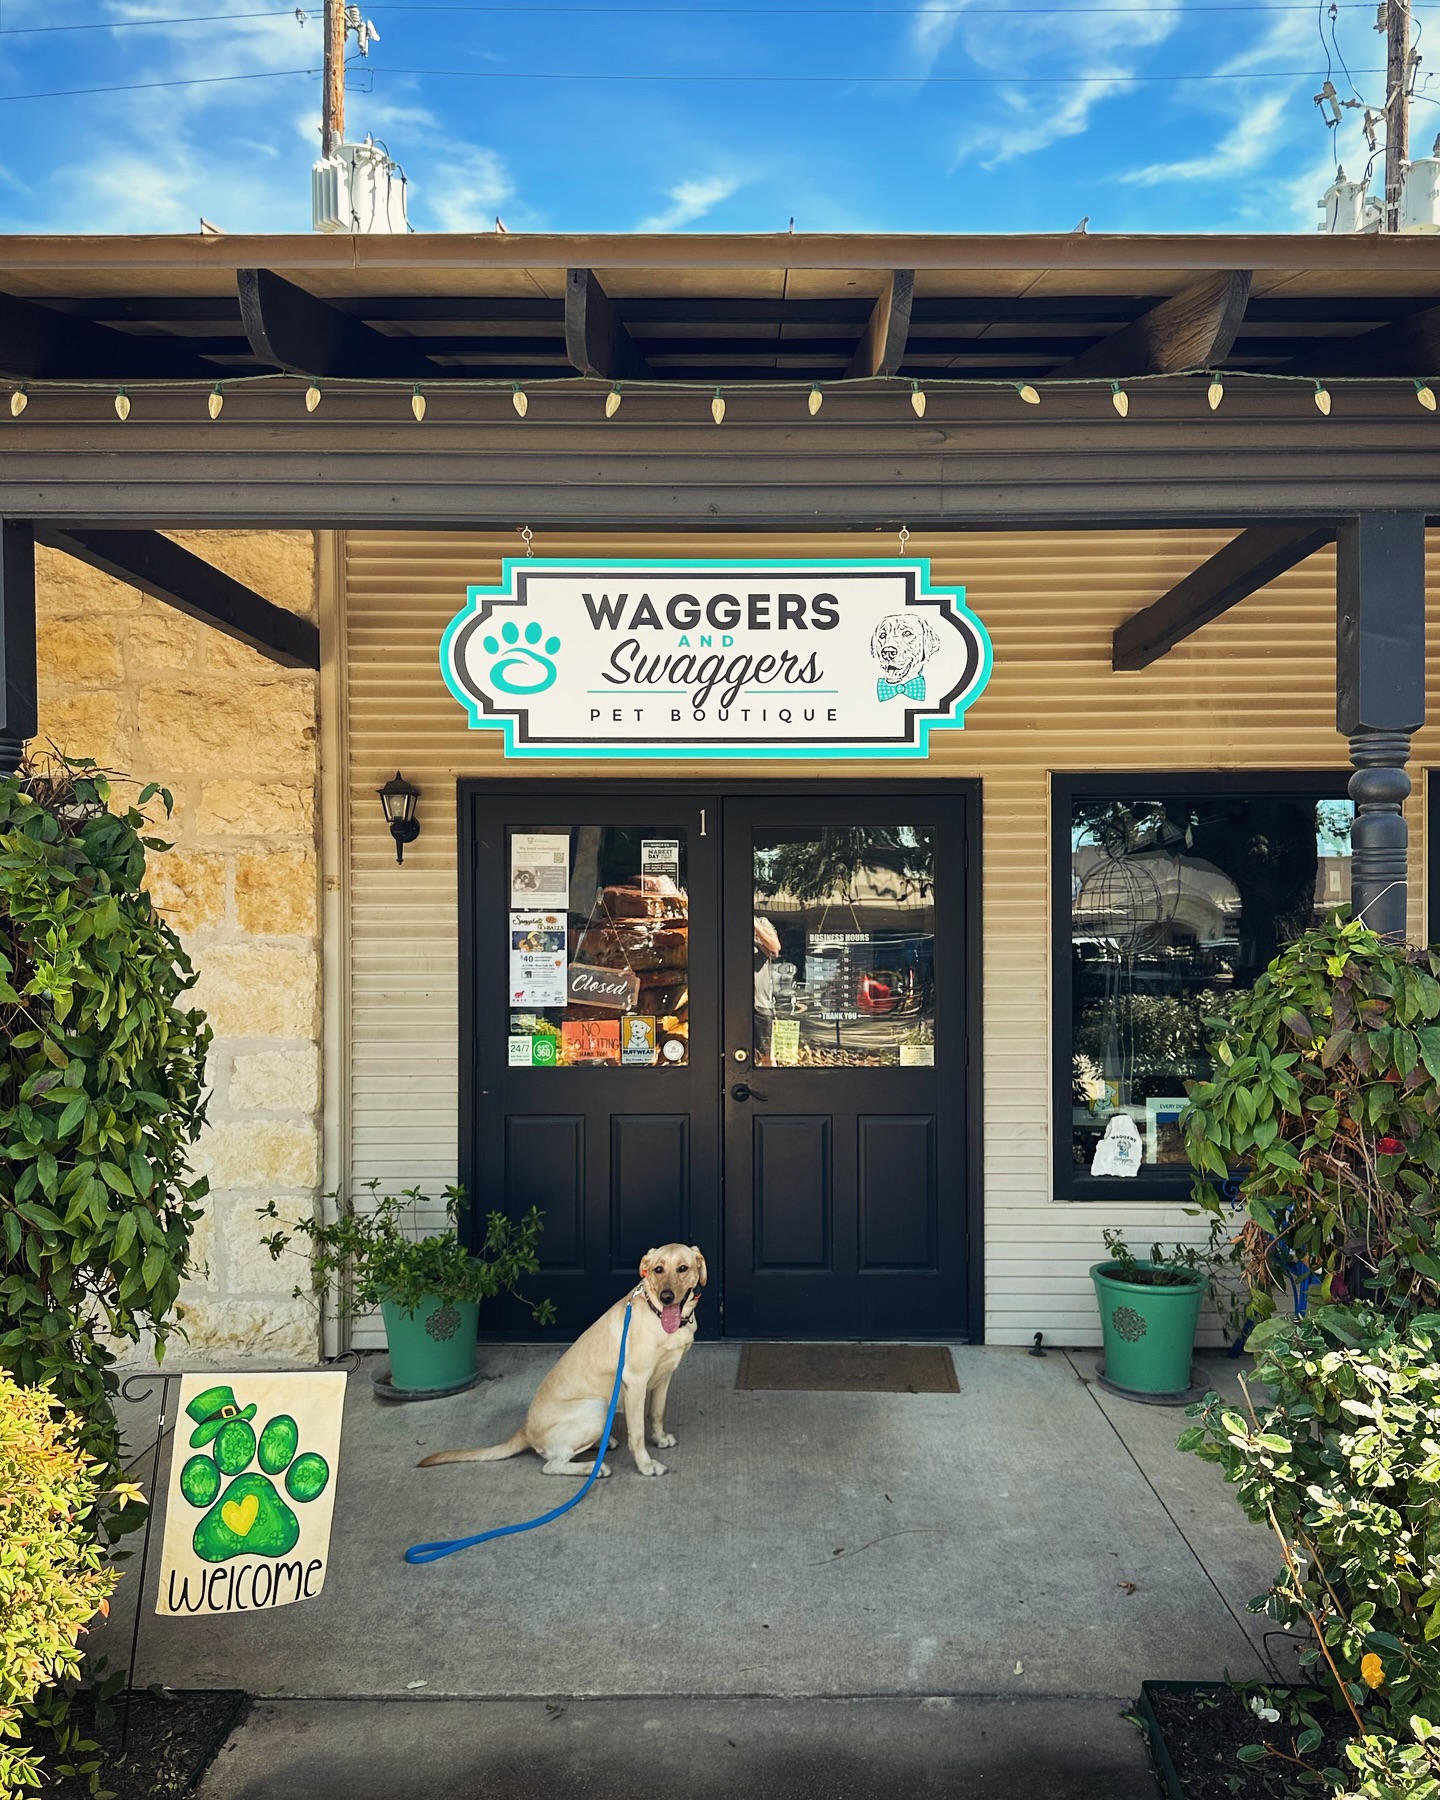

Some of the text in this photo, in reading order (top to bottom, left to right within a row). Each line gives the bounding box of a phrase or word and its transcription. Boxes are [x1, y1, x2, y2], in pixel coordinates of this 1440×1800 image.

[582, 593, 840, 631] WAGGERS
[677, 635, 735, 648] AND
[601, 638, 824, 709] Swaggers
[590, 708, 838, 723] PET BOUTIQUE
[699, 808, 707, 836] 1
[809, 933, 870, 942] BUSINESS HOURS
[572, 974, 628, 994] Closed
[822, 1011, 857, 1020] THANK YOU
[581, 1022, 600, 1037] NO
[510, 1044, 530, 1053] 24/7
[536, 1049, 551, 1057] 360
